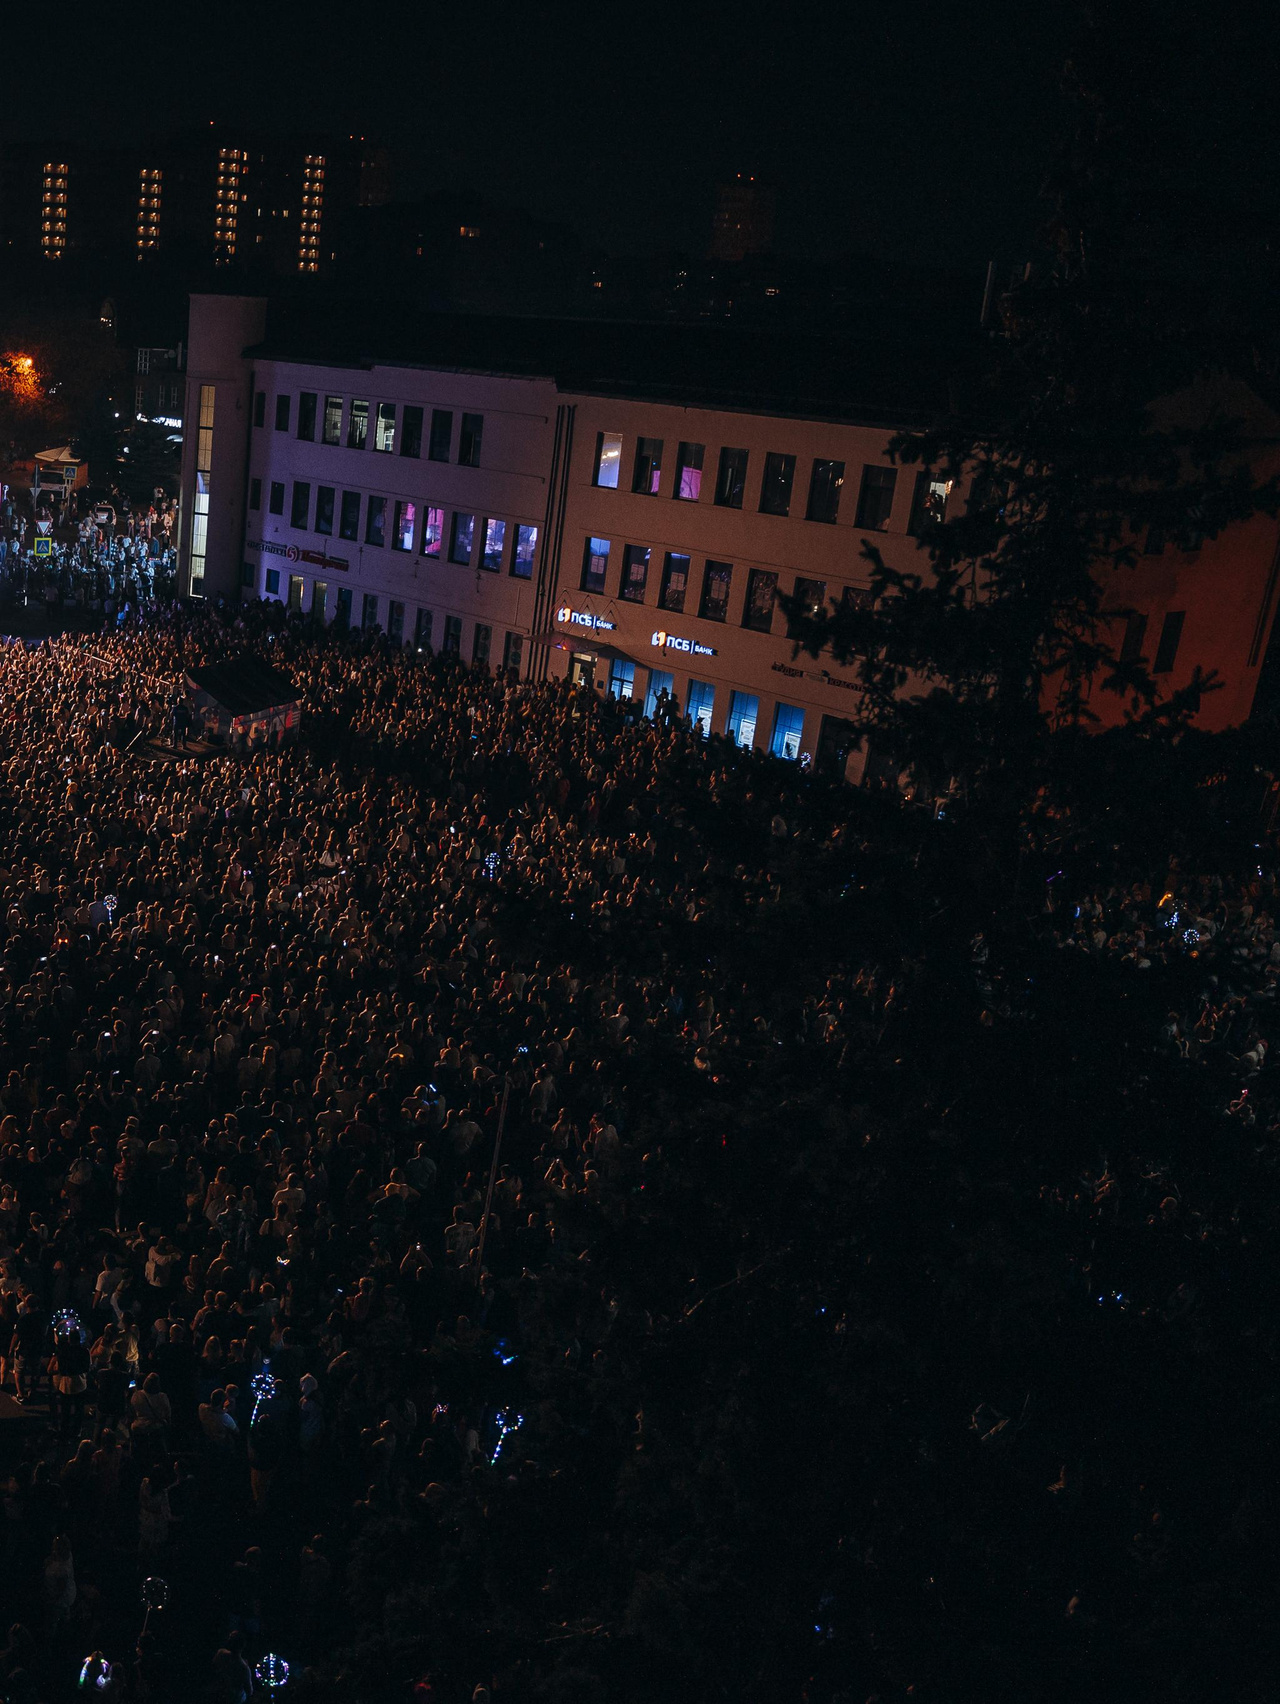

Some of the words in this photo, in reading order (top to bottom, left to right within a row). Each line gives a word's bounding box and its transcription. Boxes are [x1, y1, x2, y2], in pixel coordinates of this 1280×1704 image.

[571, 612, 593, 627] ПСБ
[596, 619, 614, 630] БАНК
[666, 636, 690, 652] ПСБ
[694, 645, 713, 656] БАНК
